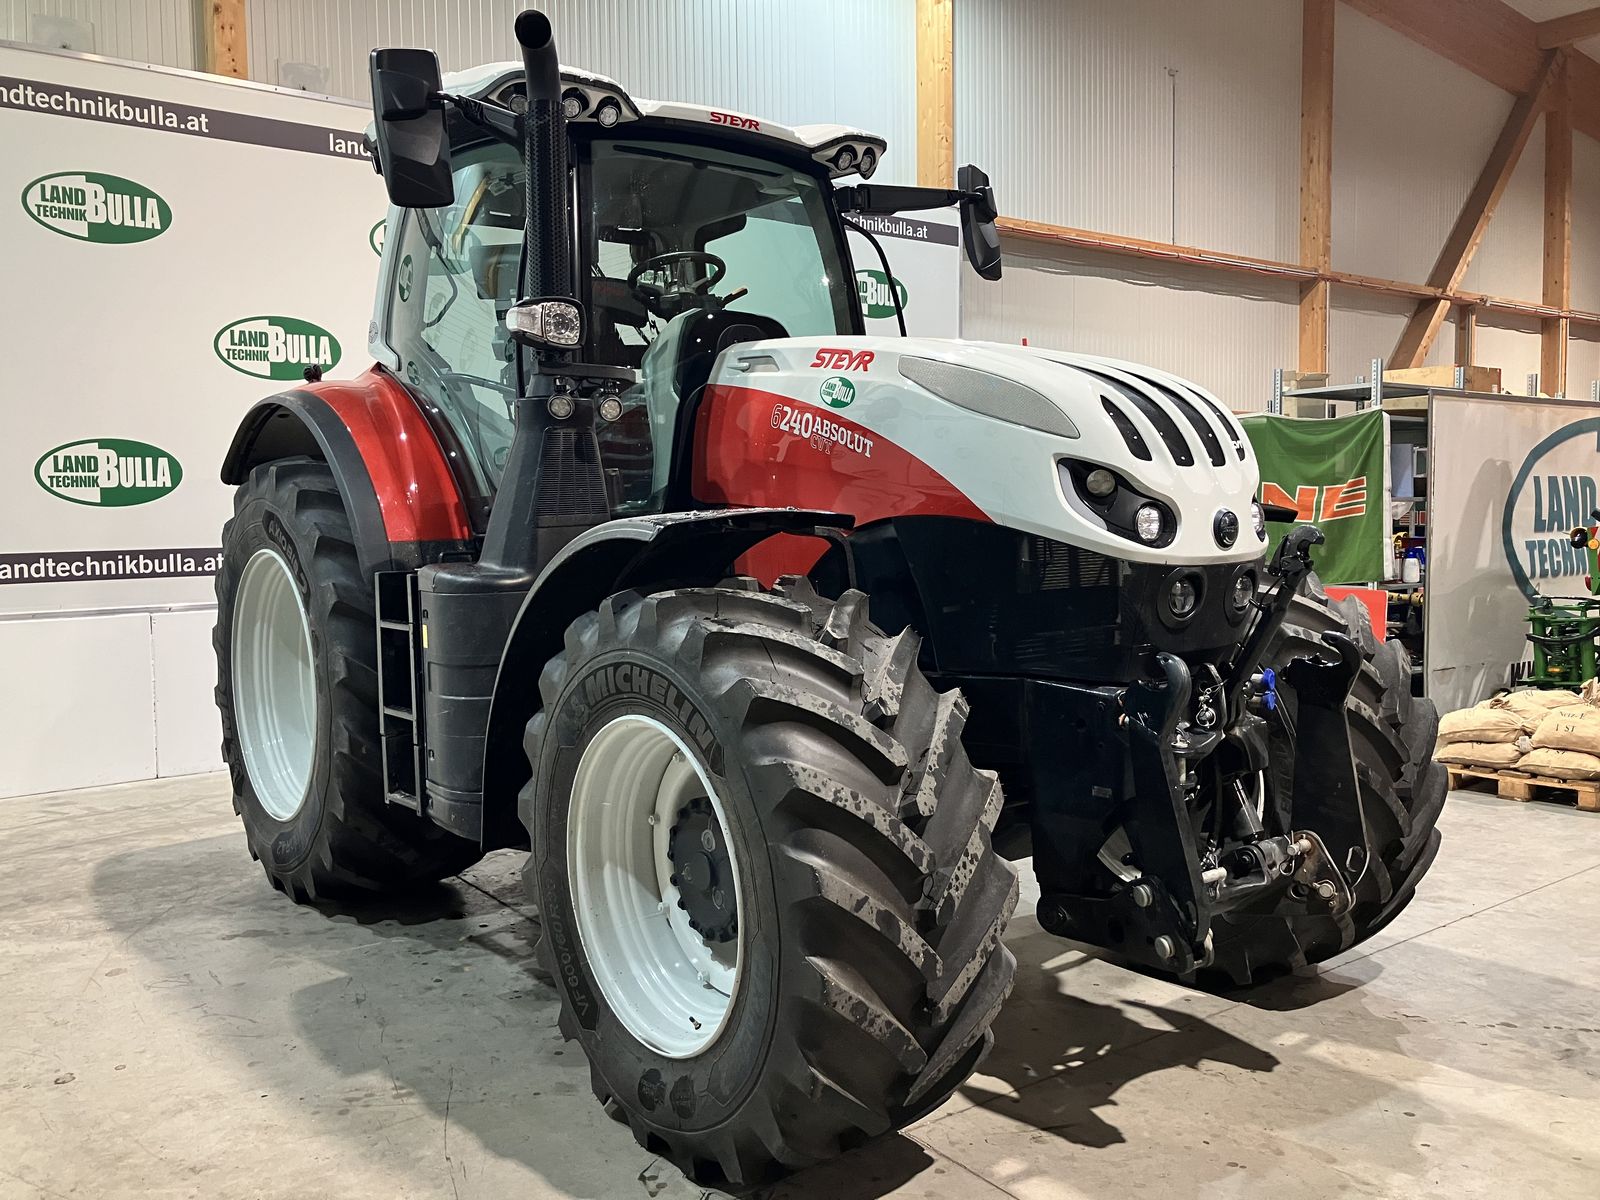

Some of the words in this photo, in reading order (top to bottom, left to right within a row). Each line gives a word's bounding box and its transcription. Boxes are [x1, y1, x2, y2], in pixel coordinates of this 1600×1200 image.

[709, 111, 760, 131] STEYR
[40, 183, 86, 206] LAND
[86, 182, 161, 230] BULLA
[35, 203, 87, 222] TECHNIK
[229, 329, 269, 348] LAND
[269, 325, 332, 365] BULLA
[225, 348, 269, 362] TECHNIK
[810, 347, 875, 372] STEYR
[771, 403, 813, 438] 6240
[813, 416, 873, 457] ABSOLUT
[53, 455, 99, 473] LAND
[98, 448, 172, 488] BULLA
[48, 475, 100, 488] TECHNIK
[1261, 476, 1366, 522] NE
[1533, 475, 1597, 533] LAND
[585, 664, 714, 750] MICHELIN
